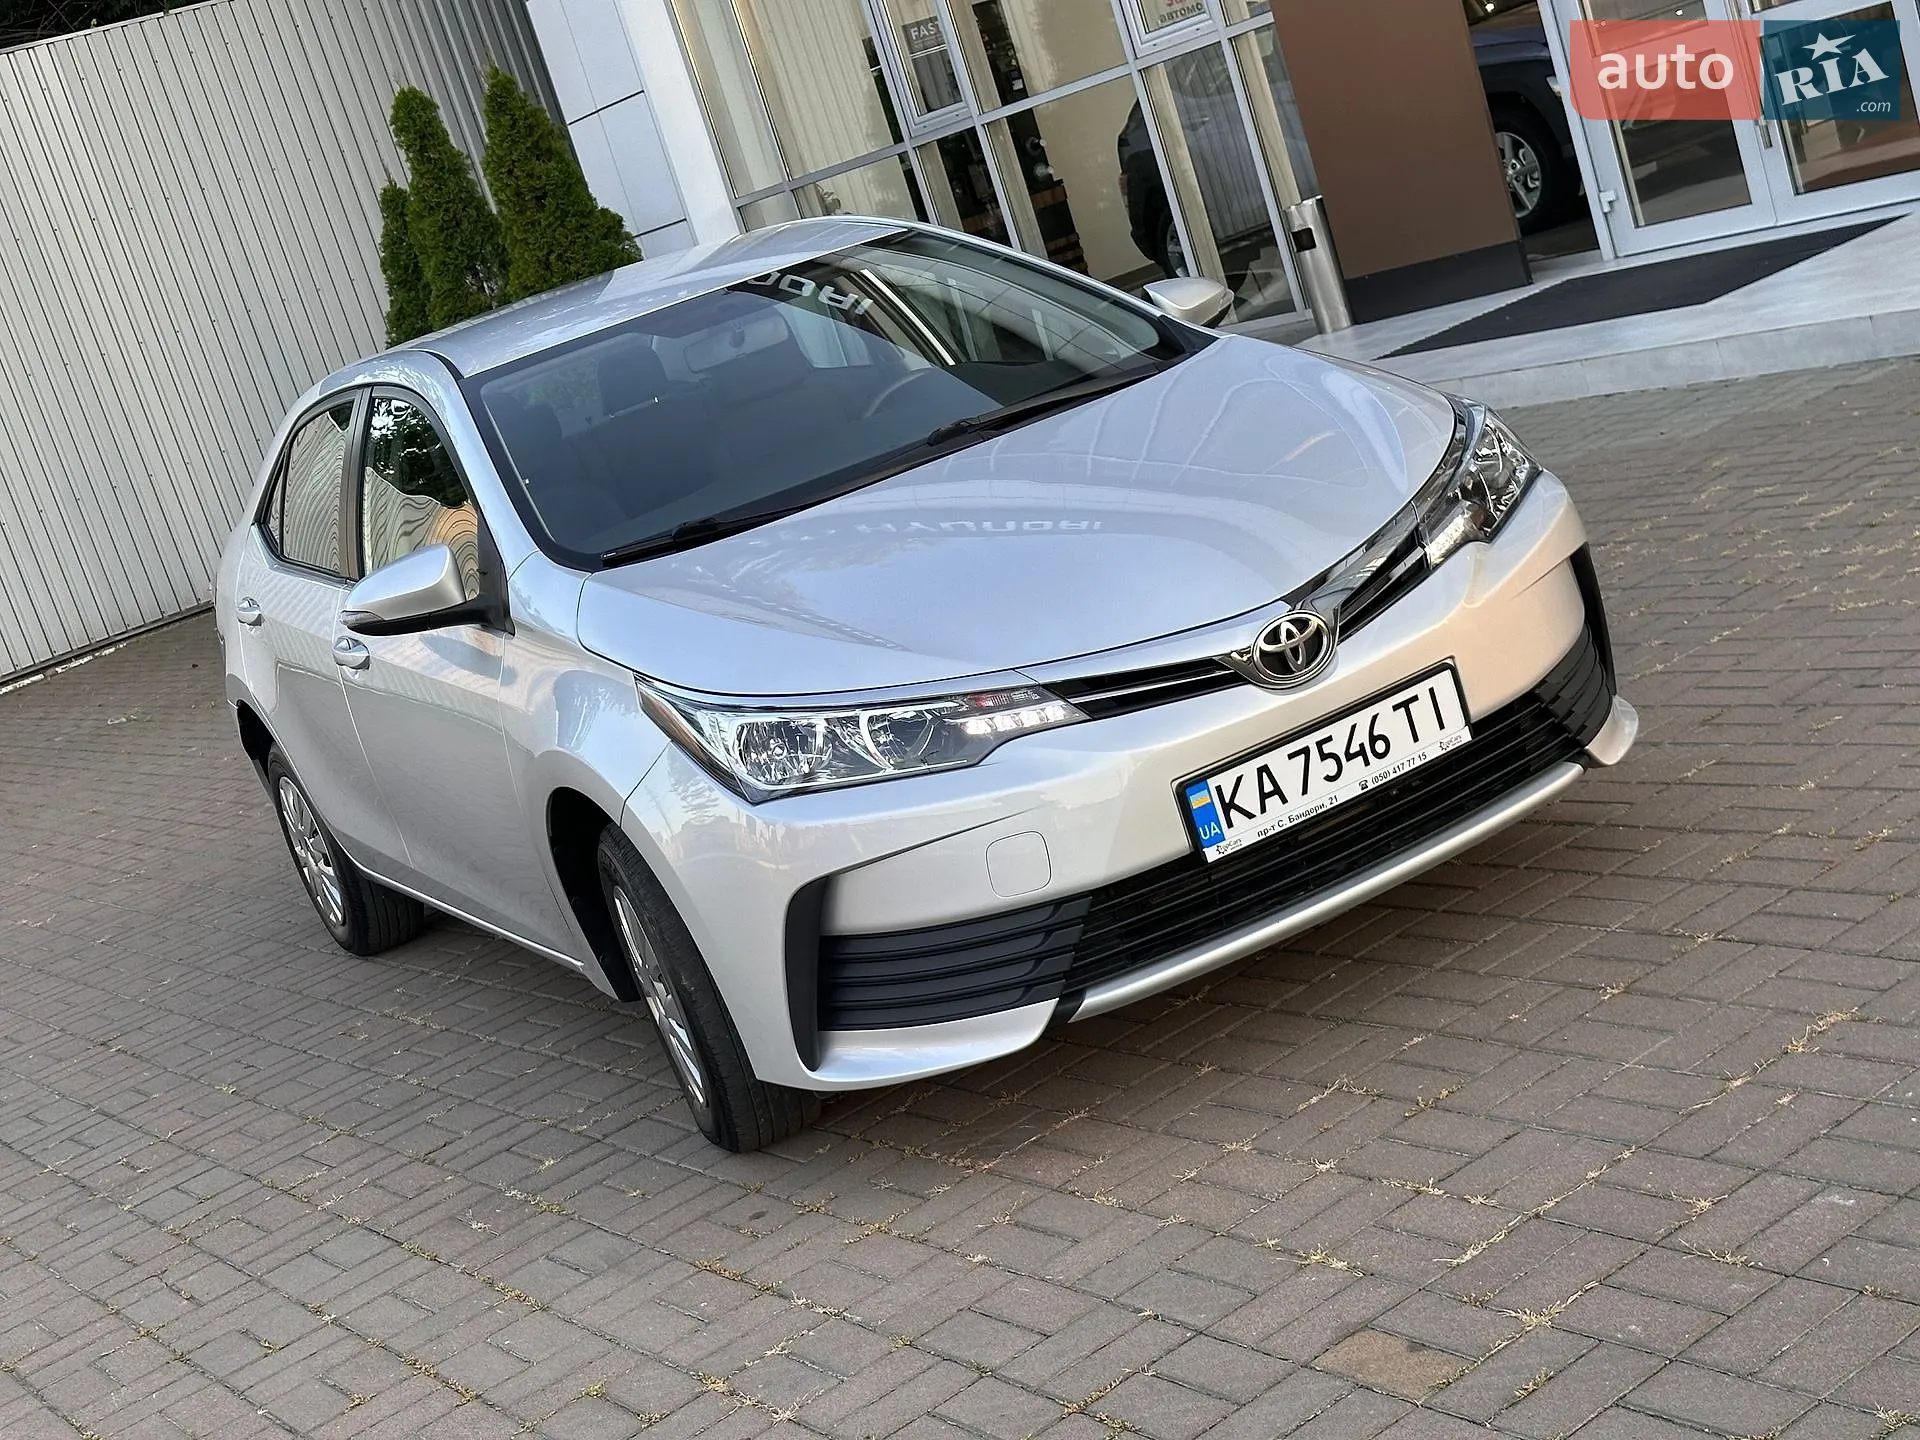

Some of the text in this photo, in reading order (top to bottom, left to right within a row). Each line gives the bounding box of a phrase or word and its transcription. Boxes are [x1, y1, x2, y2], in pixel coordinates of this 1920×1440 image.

[1214, 686, 1446, 829] KA 7546 TI
[1370, 752, 1427, 786] (050) 417 77 15
[1328, 795, 1338, 807] 21
[1199, 823, 1222, 841] UA
